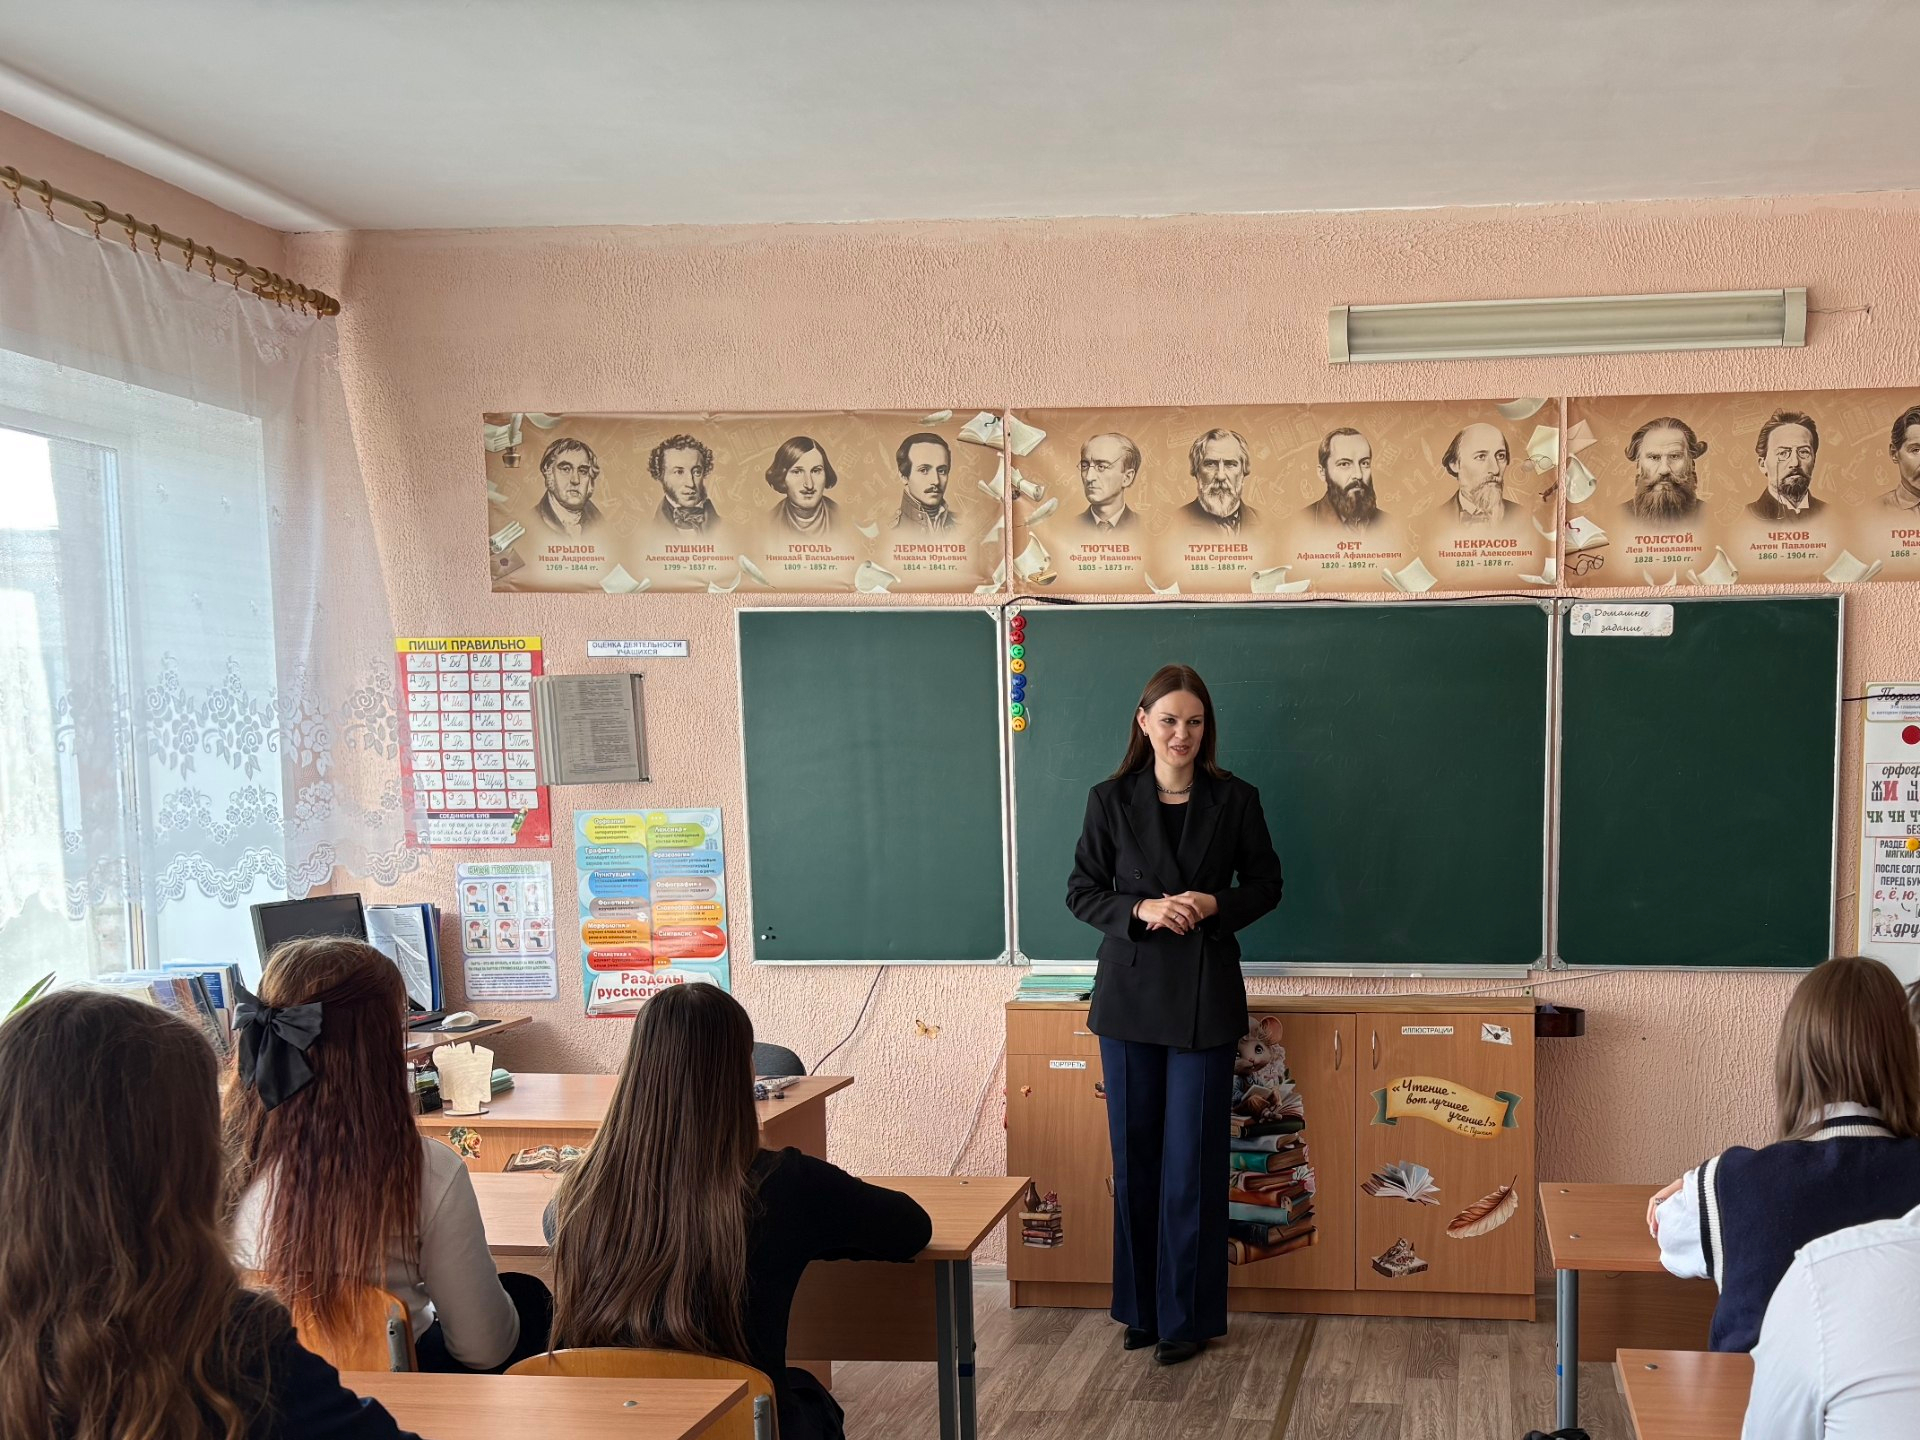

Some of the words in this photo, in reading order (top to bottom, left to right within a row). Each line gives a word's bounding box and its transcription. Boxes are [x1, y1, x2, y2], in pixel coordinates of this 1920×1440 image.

[1635, 533, 1693, 545] ТОЛСТОЙ
[1768, 532, 1810, 541] ЧЕХОВ
[789, 544, 832, 553] ГОГОЛЬ
[894, 544, 966, 553] ЛЕРМОНТОВ
[1081, 544, 1130, 553] ТЮТЧЕВ
[1189, 544, 1248, 553] ТУРГЕНЕВ
[1337, 542, 1362, 551] ФЕТ
[1454, 539, 1518, 549] НЕКРАСОВ
[1782, 541, 1827, 550] Павлович
[548, 545, 595, 554] КРЫЛОВ
[665, 545, 715, 554] ПУШКИН
[1438, 549, 1478, 558] Николай
[1480, 549, 1533, 557] Алексеевич
[1626, 546, 1644, 554] Лев
[1646, 545, 1702, 553] Николаевич
[1890, 550, 1910, 558] 1868
[929, 554, 968, 562] Юрьевич
[1070, 553, 1097, 562] Фёдор
[1209, 554, 1253, 562] Сергеевич
[1297, 551, 1341, 561] Афанасий
[1342, 551, 1402, 560] Афанасьевич
[1594, 609, 1651, 617] Домашнее
[1601, 623, 1642, 633] задание
[409, 640, 447, 650] ПИШИ
[452, 640, 526, 650] ПРАВИЛЬНО
[473, 654, 478, 662] В
[476, 733, 481, 741] С
[1867, 811, 1883, 823] ЧК
[1888, 811, 1905, 822] ЧН
[1910, 810, 1920, 822] Ч
[1876, 864, 1900, 873] ПОСЛЕ
[1881, 876, 1905, 886] ПЕРЕД
[621, 973, 684, 985] Разделы
[1406, 1093, 1428, 1104] вот
[1429, 1098, 1470, 1112] лучшее
[1447, 1111, 1496, 1127] учение!»
